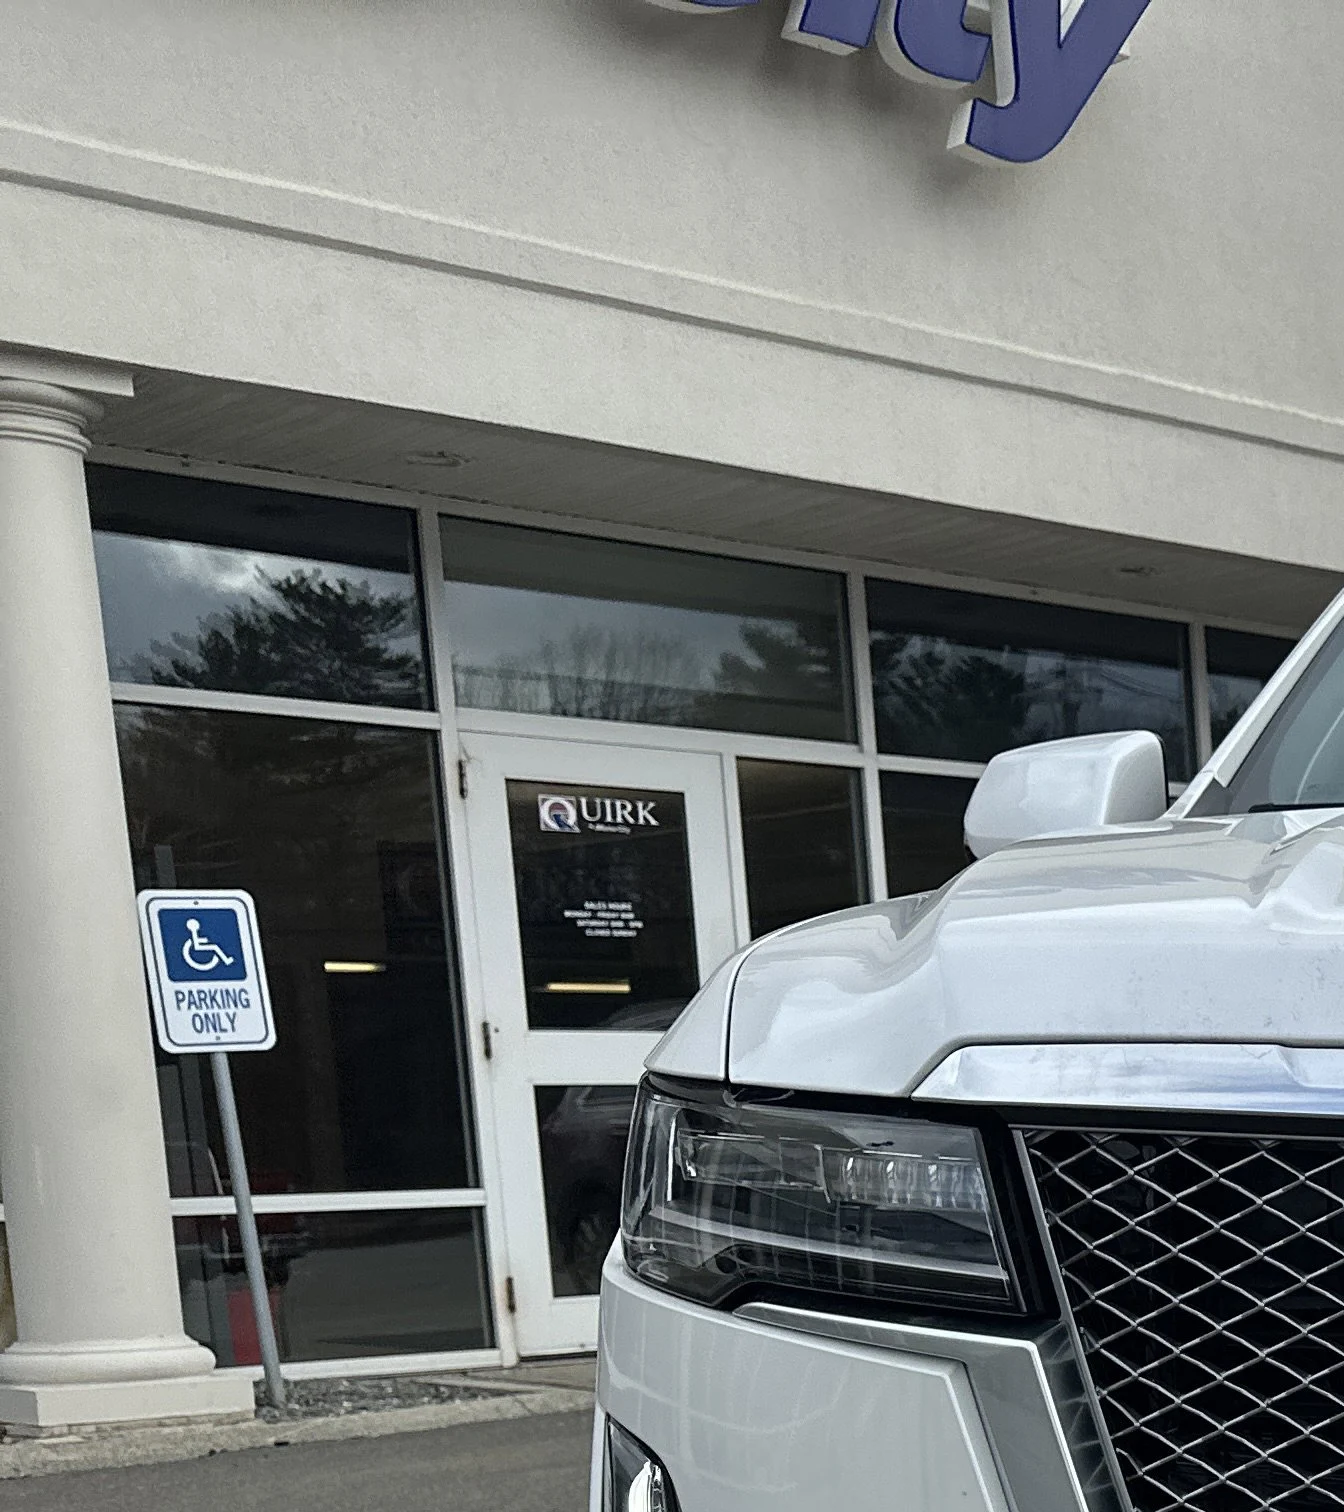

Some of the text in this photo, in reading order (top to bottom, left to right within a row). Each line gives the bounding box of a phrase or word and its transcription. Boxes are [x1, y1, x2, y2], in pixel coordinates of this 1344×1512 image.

[538, 794, 660, 834] QUIRK
[174, 988, 250, 1011] PARKING
[192, 1012, 237, 1034] ONLY
